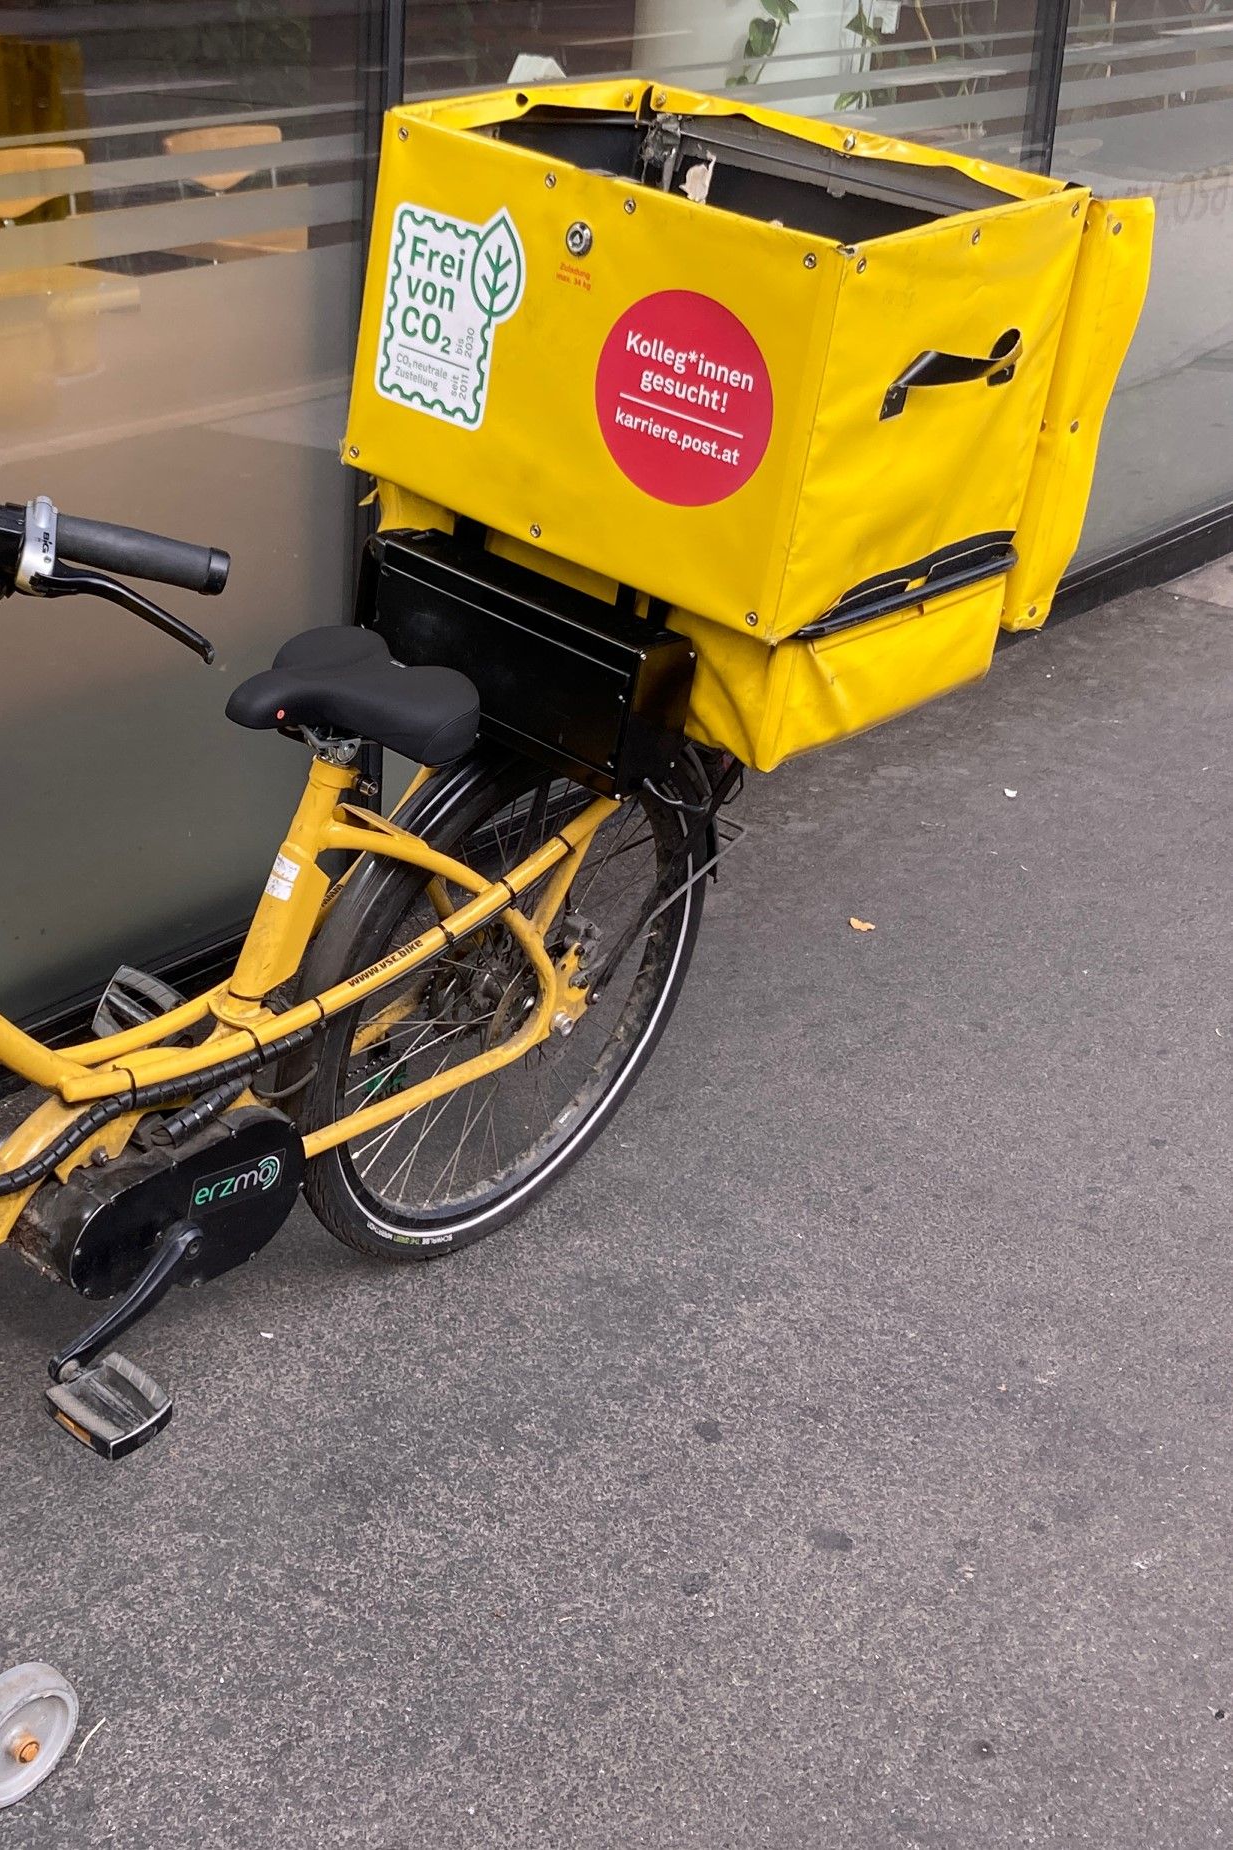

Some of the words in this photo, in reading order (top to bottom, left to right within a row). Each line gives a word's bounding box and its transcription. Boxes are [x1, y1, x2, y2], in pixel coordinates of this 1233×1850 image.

[409, 236, 466, 282] Frei
[406, 274, 456, 312] von
[455, 338, 465, 356] bis
[464, 327, 476, 359] 2030
[395, 366, 438, 393] Zustellung
[450, 374, 460, 397] seit
[458, 374, 470, 400] 2011
[639, 370, 729, 414] gesucht!
[614, 406, 741, 466] karriere.post.at
